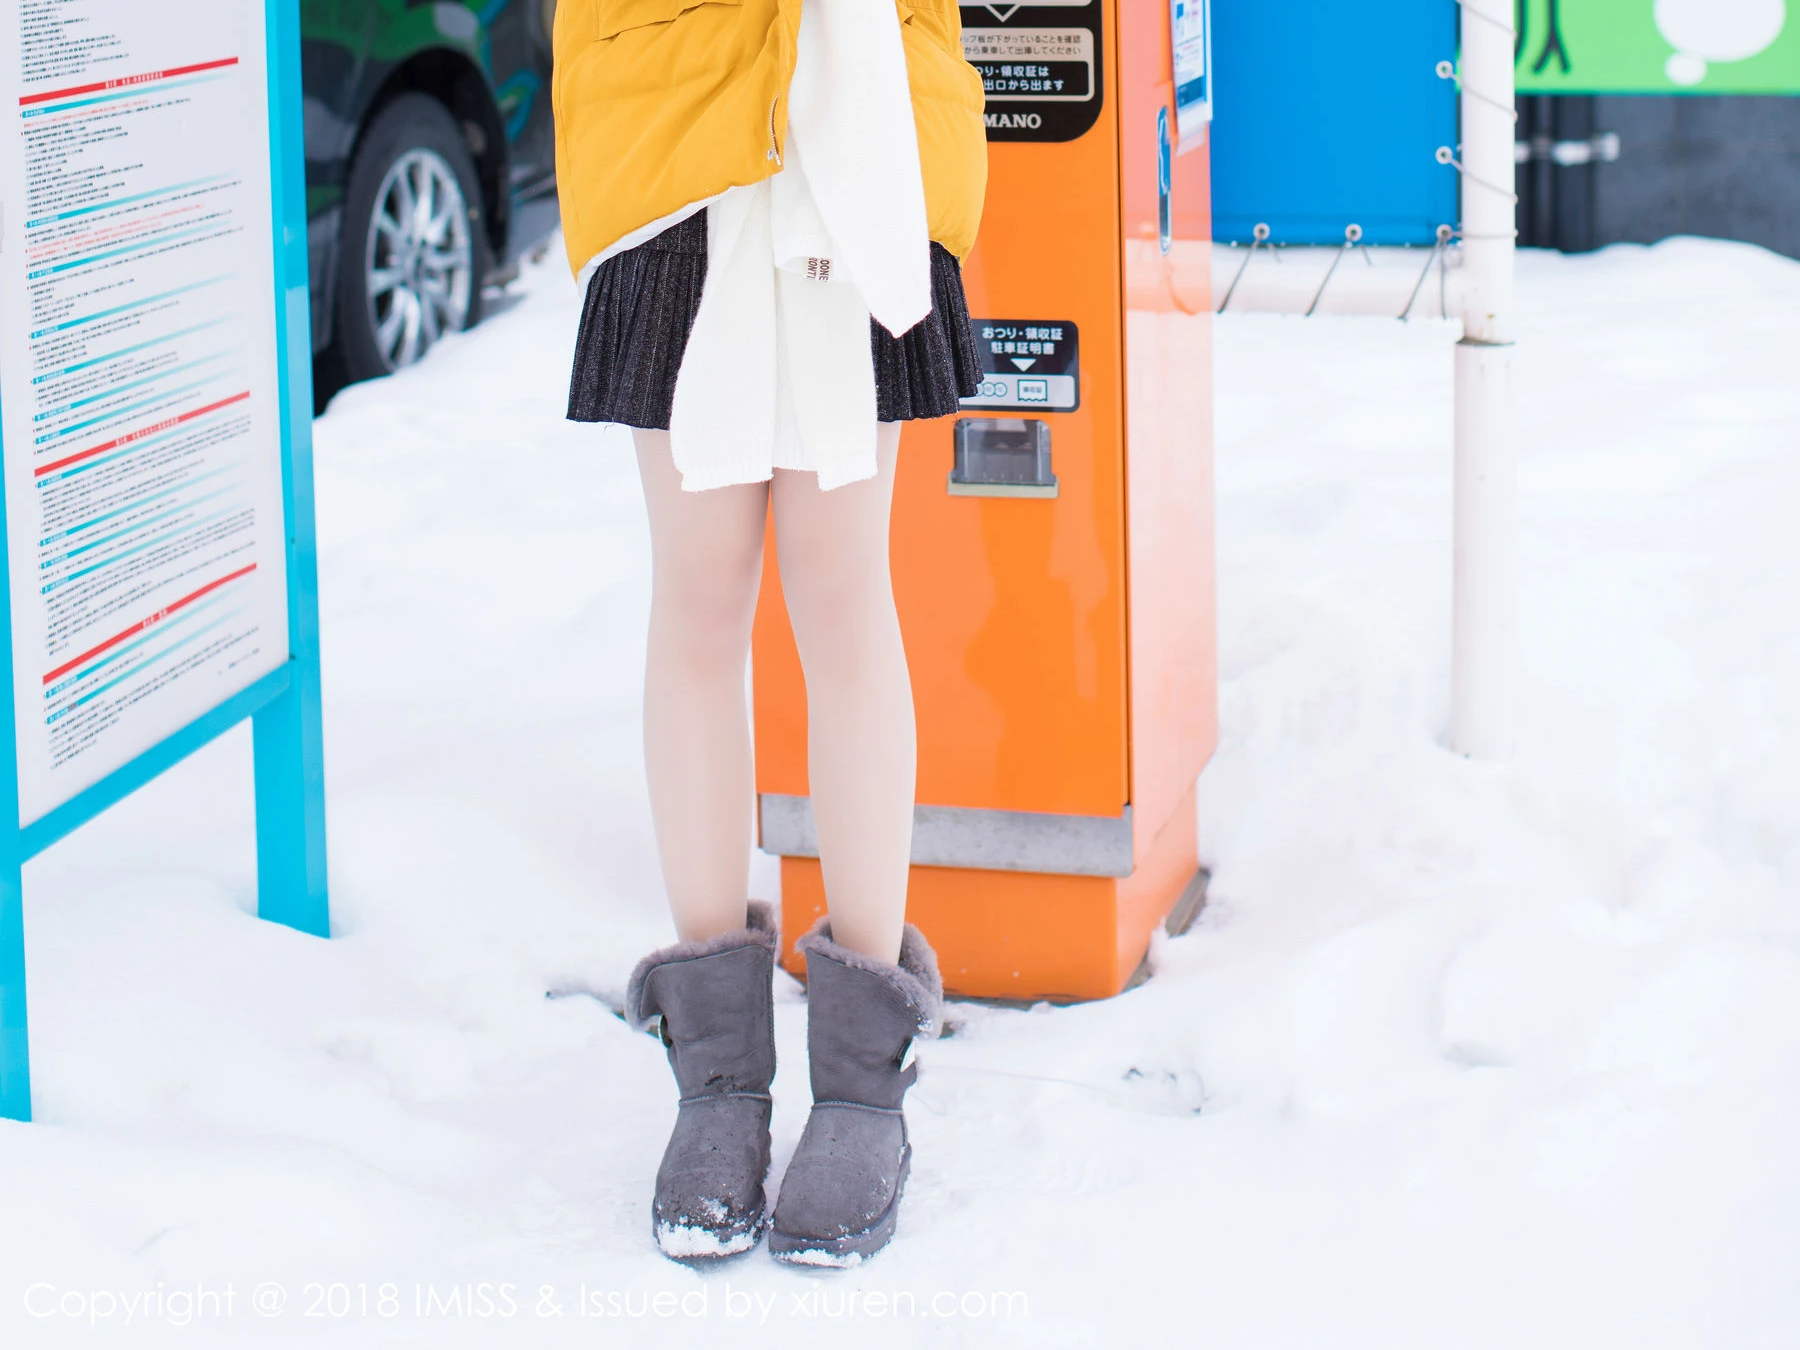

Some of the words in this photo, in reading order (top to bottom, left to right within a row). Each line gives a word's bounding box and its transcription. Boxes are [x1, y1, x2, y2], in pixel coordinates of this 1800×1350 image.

[961, 34, 1081, 44] ップ板が下がっていることを確認
[984, 80, 1064, 91] 出口から出ます
[984, 114, 1042, 129] MANO
